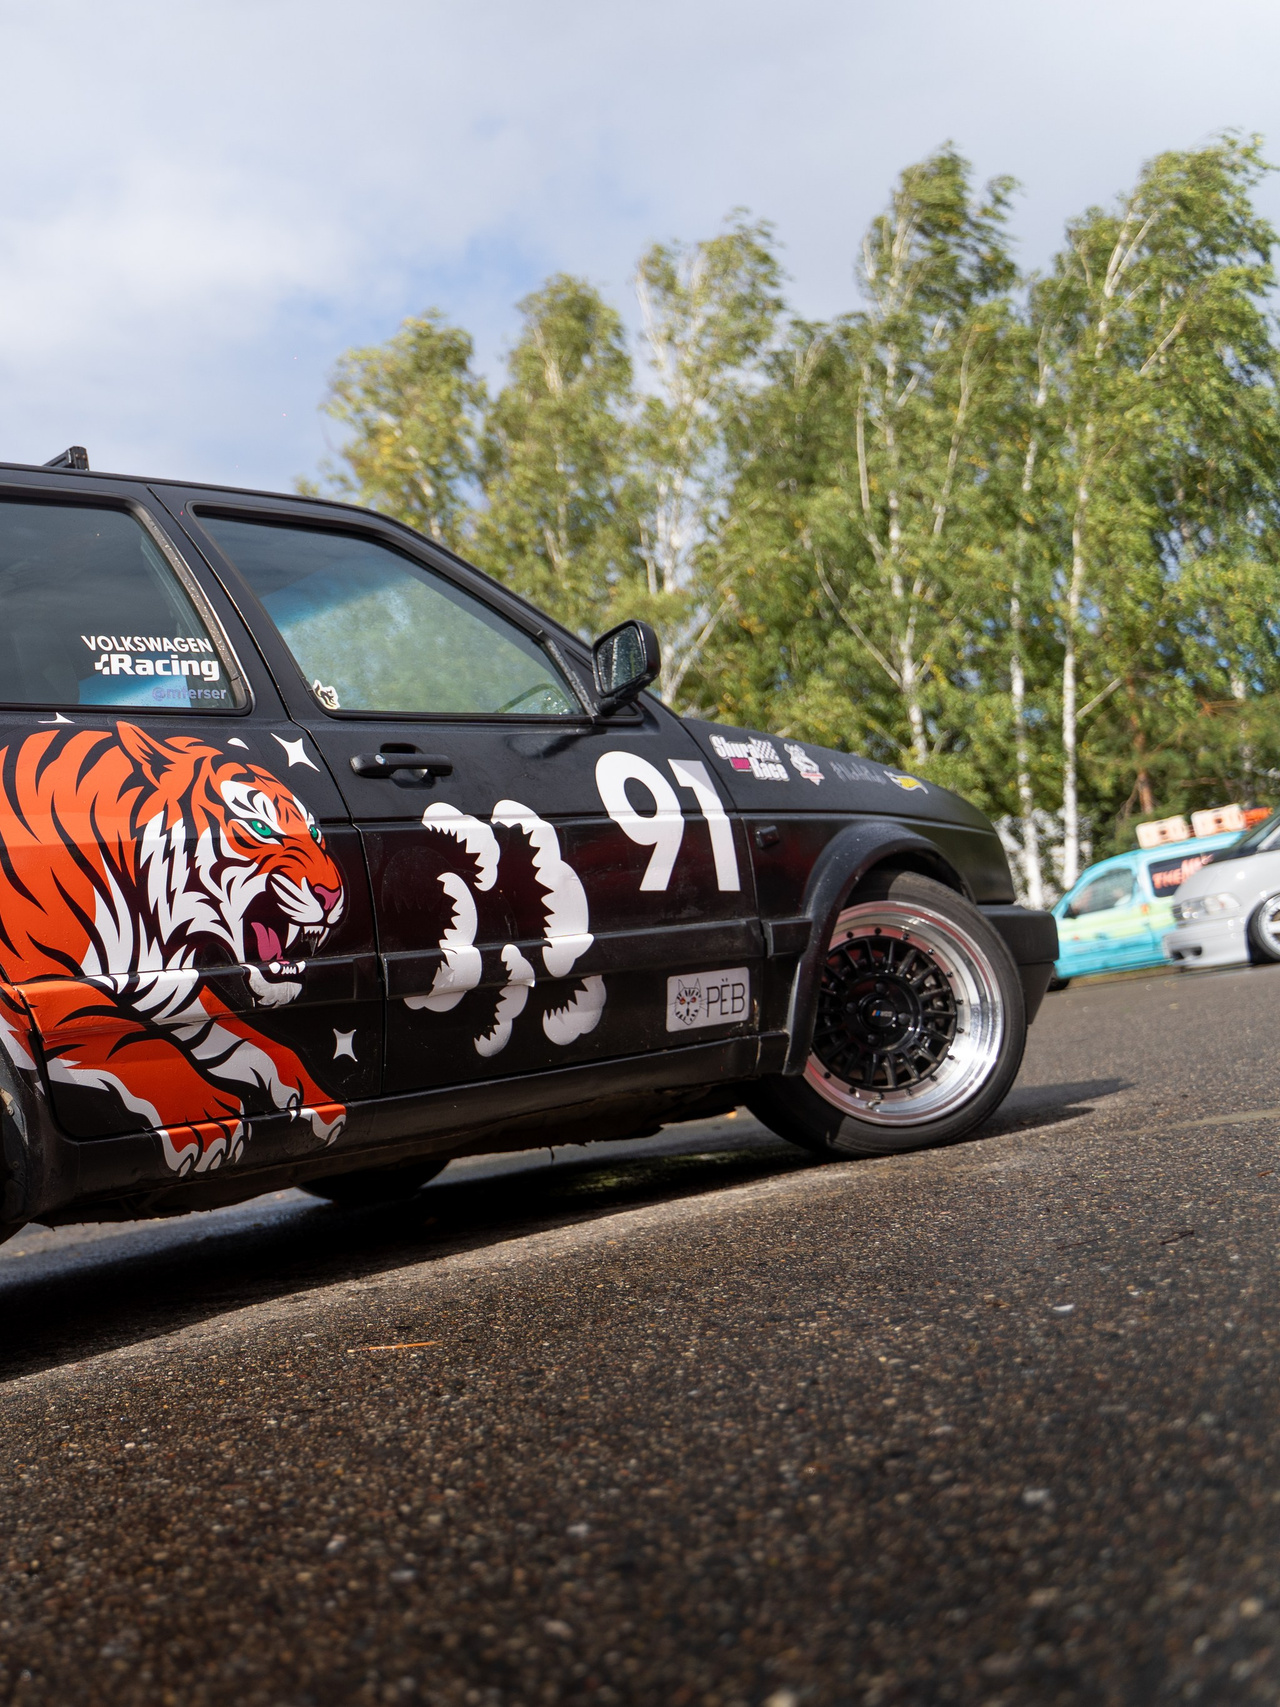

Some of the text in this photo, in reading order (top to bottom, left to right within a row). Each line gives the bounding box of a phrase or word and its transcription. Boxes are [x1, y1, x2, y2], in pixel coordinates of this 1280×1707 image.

[80, 635, 214, 653] VOLKSWAGEN
[110, 653, 220, 681] Racing
[748, 757, 790, 781] Race
[594, 750, 741, 891] 91
